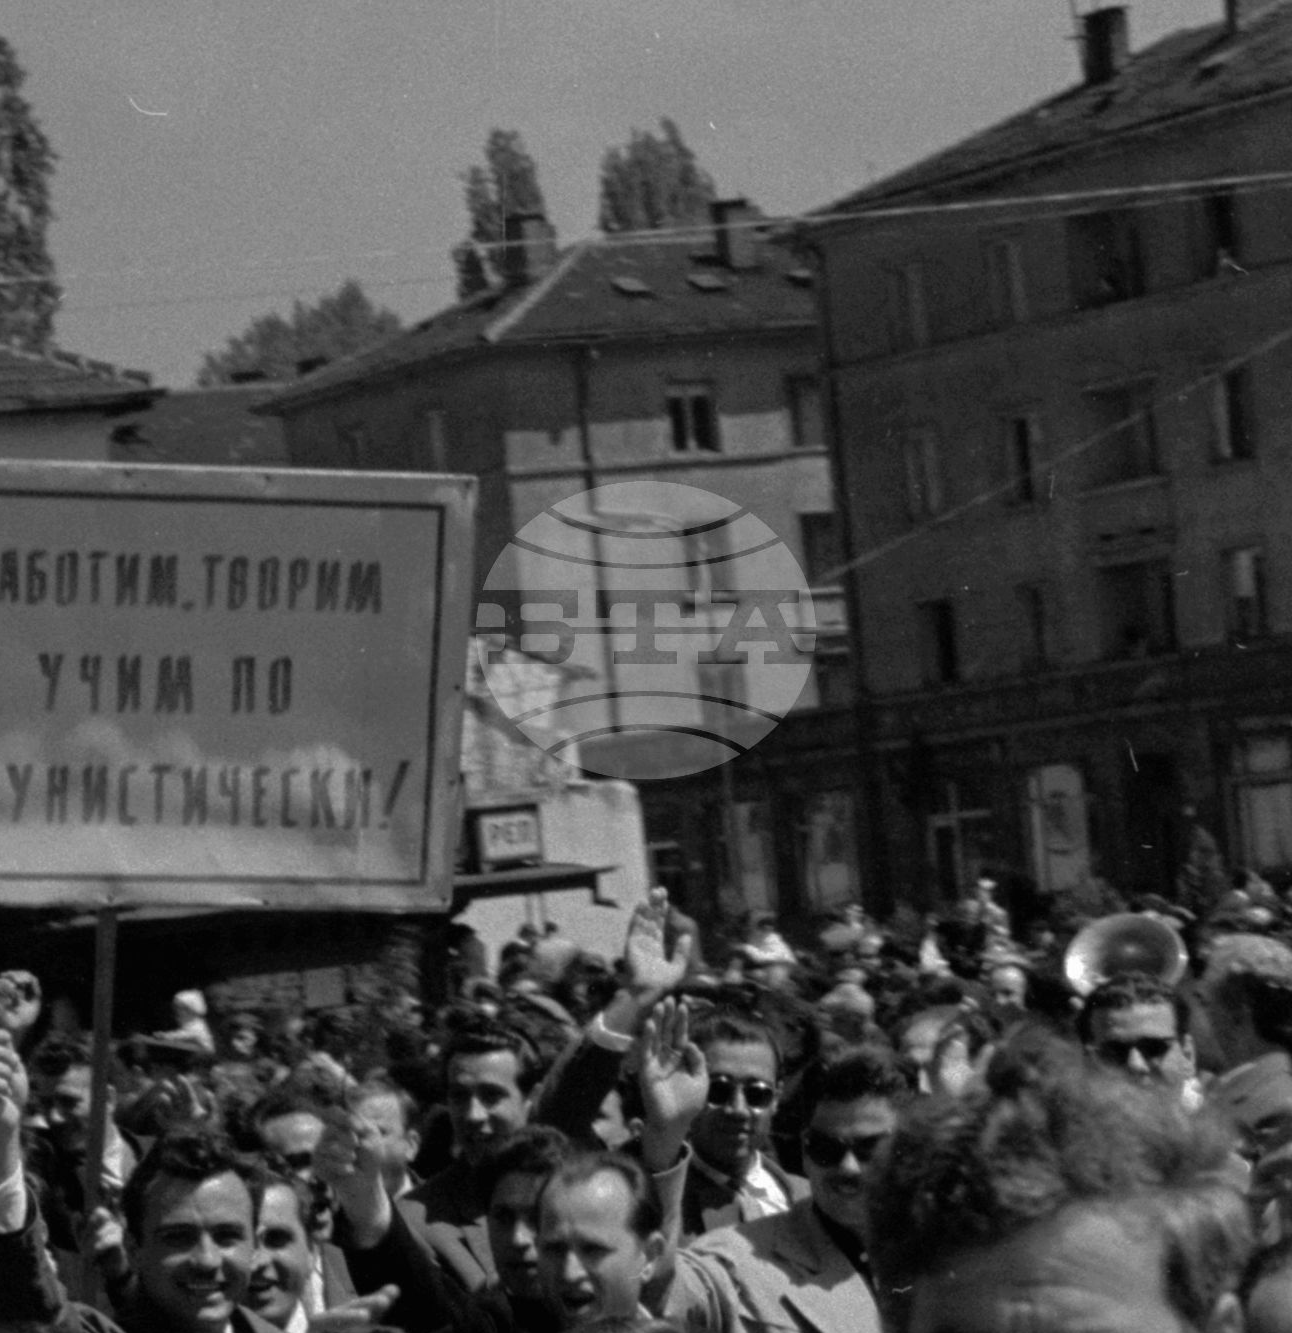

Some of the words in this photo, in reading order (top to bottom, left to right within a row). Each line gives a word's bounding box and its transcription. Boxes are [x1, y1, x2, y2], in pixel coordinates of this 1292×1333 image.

[203, 554, 383, 614] ТВОРИМ
[38, 652, 194, 714] УЧИМ
[231, 655, 293, 715] ПО
